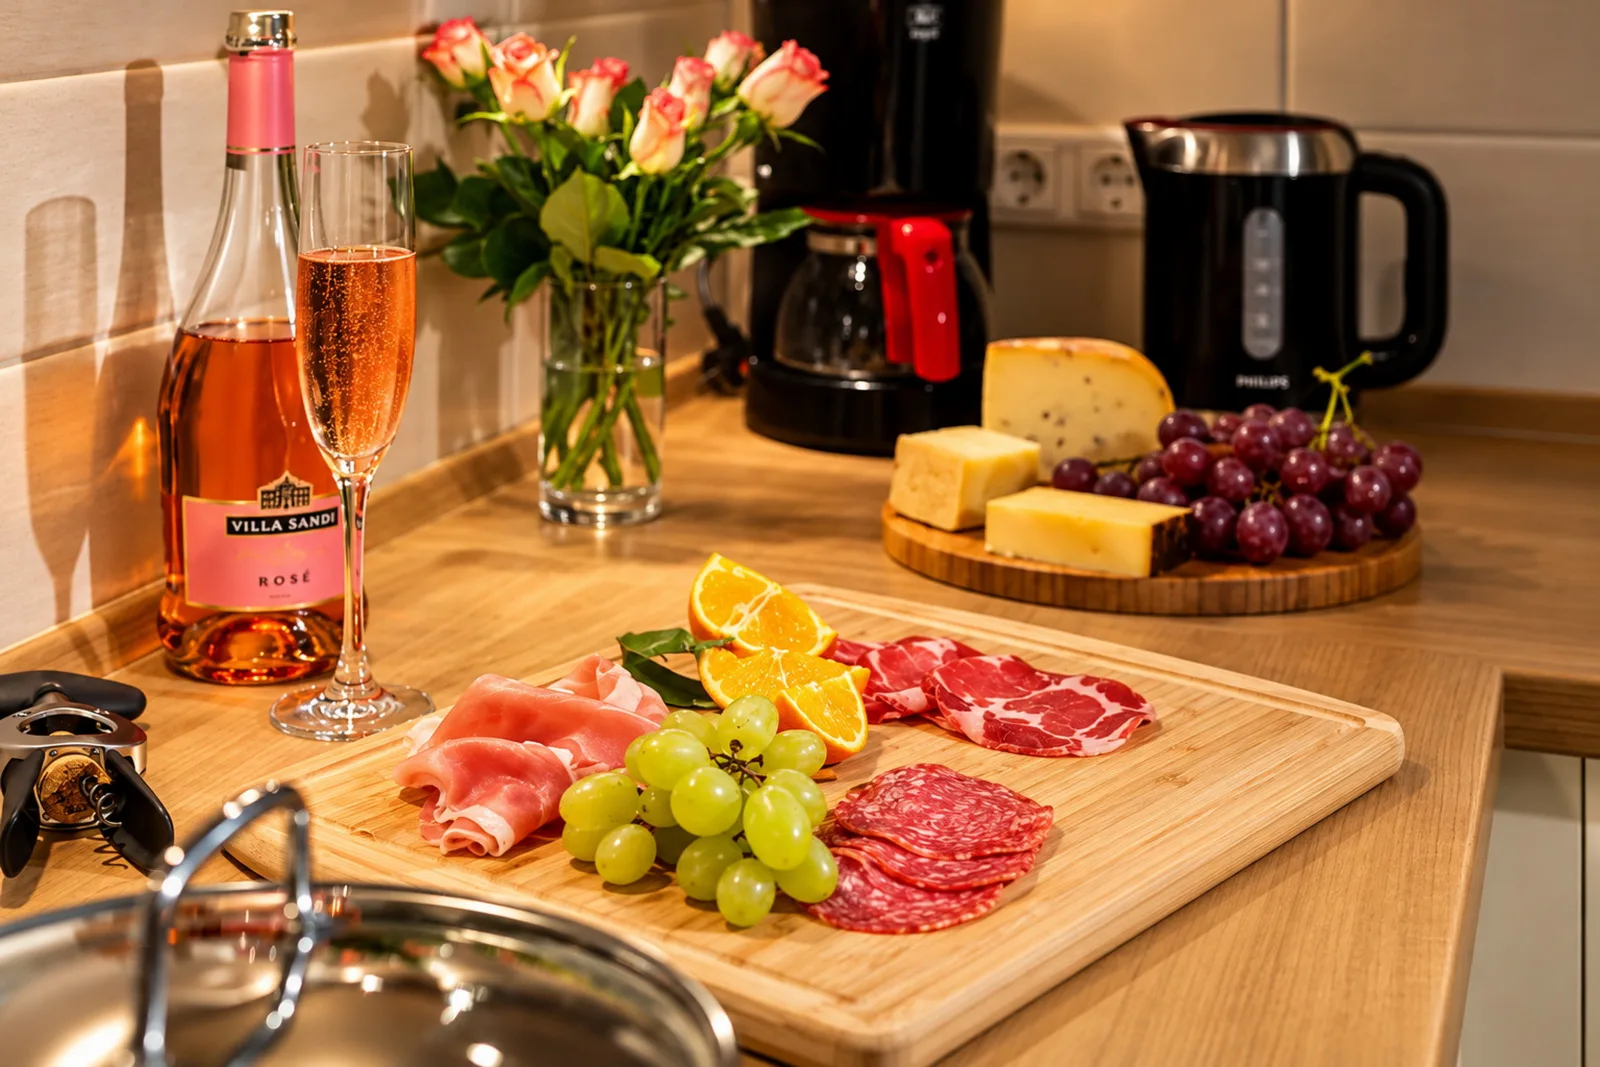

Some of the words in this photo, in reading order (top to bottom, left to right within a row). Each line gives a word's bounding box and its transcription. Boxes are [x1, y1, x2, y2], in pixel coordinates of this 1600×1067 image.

[1236, 375, 1289, 389] PHILIPS
[231, 519, 283, 532] VILLA
[288, 512, 335, 530] SANDI
[258, 569, 310, 587] ROSÉ
